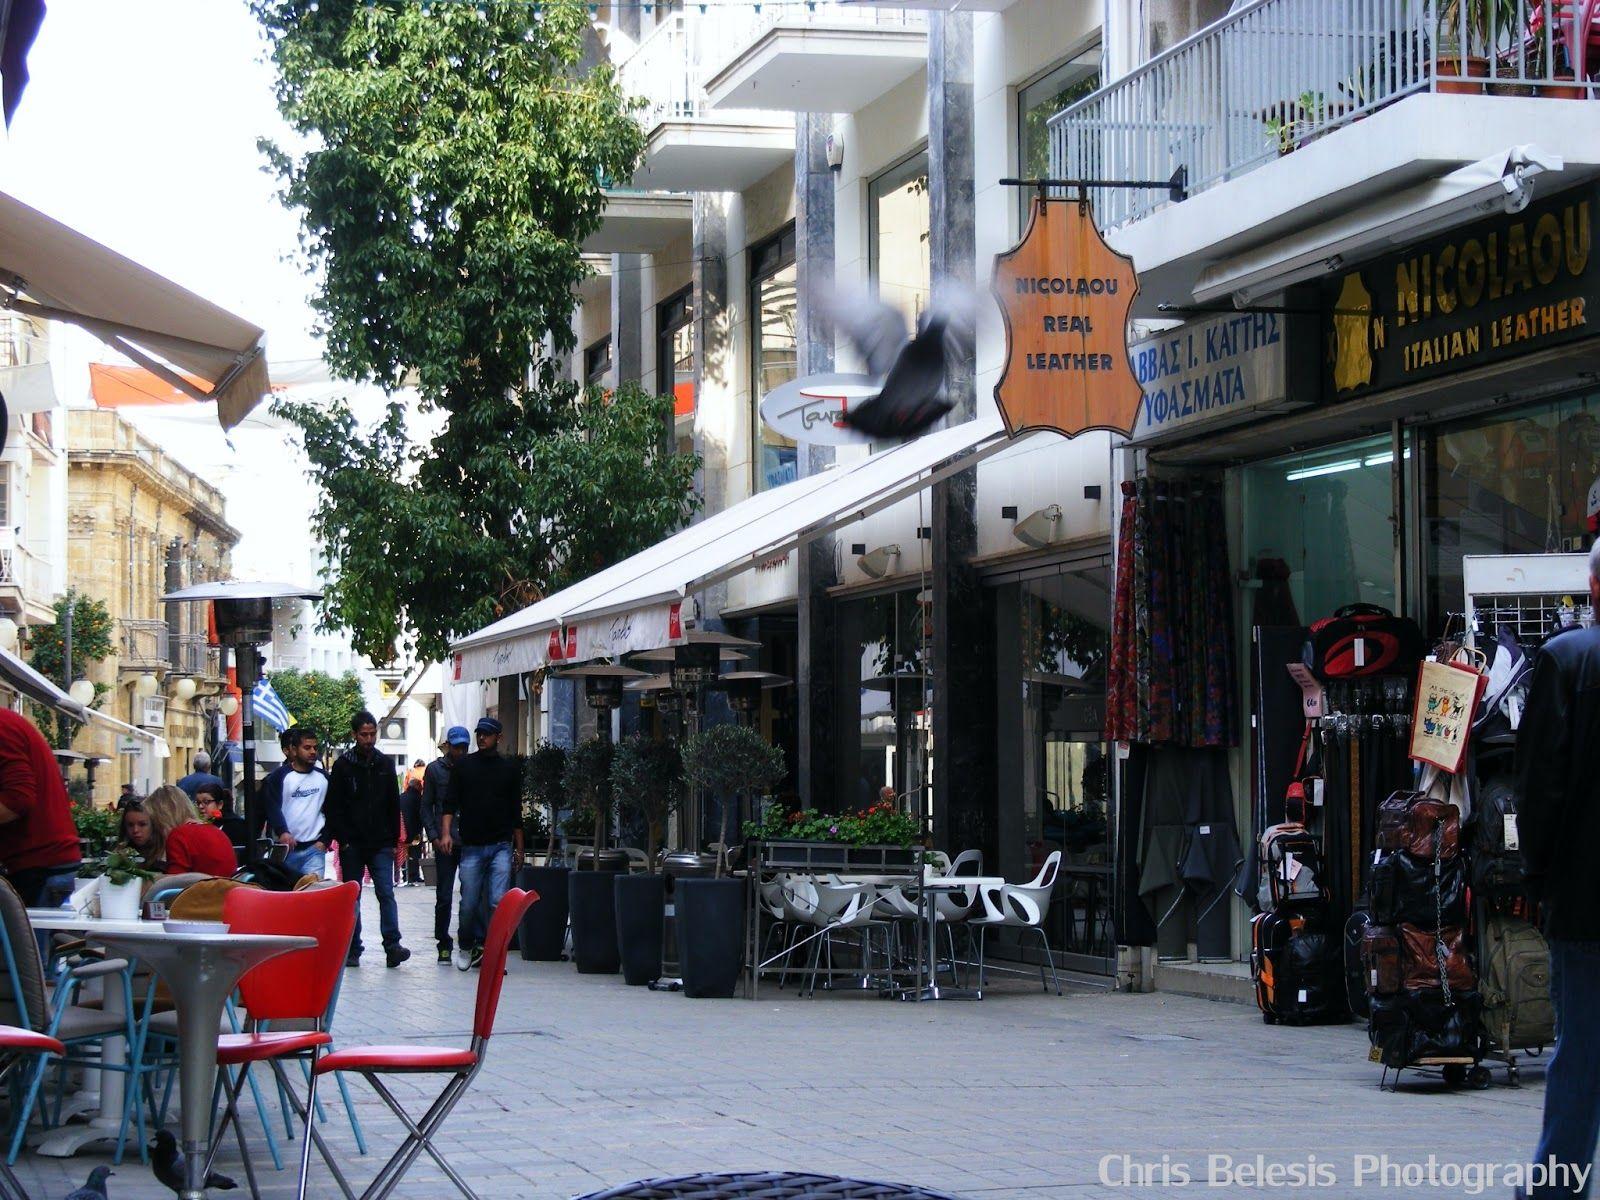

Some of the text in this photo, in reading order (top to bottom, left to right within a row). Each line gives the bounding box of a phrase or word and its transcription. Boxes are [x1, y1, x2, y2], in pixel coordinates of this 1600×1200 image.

[1015, 277, 1118, 295] NICOLAOU
[1396, 202, 1591, 327] NICOLAOU
[1043, 315, 1093, 333] REAL
[1206, 311, 1280, 364] ΚΑΤΤΗΣ
[1403, 296, 1587, 372] ITALIAN LEATHER
[1026, 352, 1113, 371] LEATHER
[1143, 365, 1245, 426] ΥΦΑΣΜΑΤΑ
